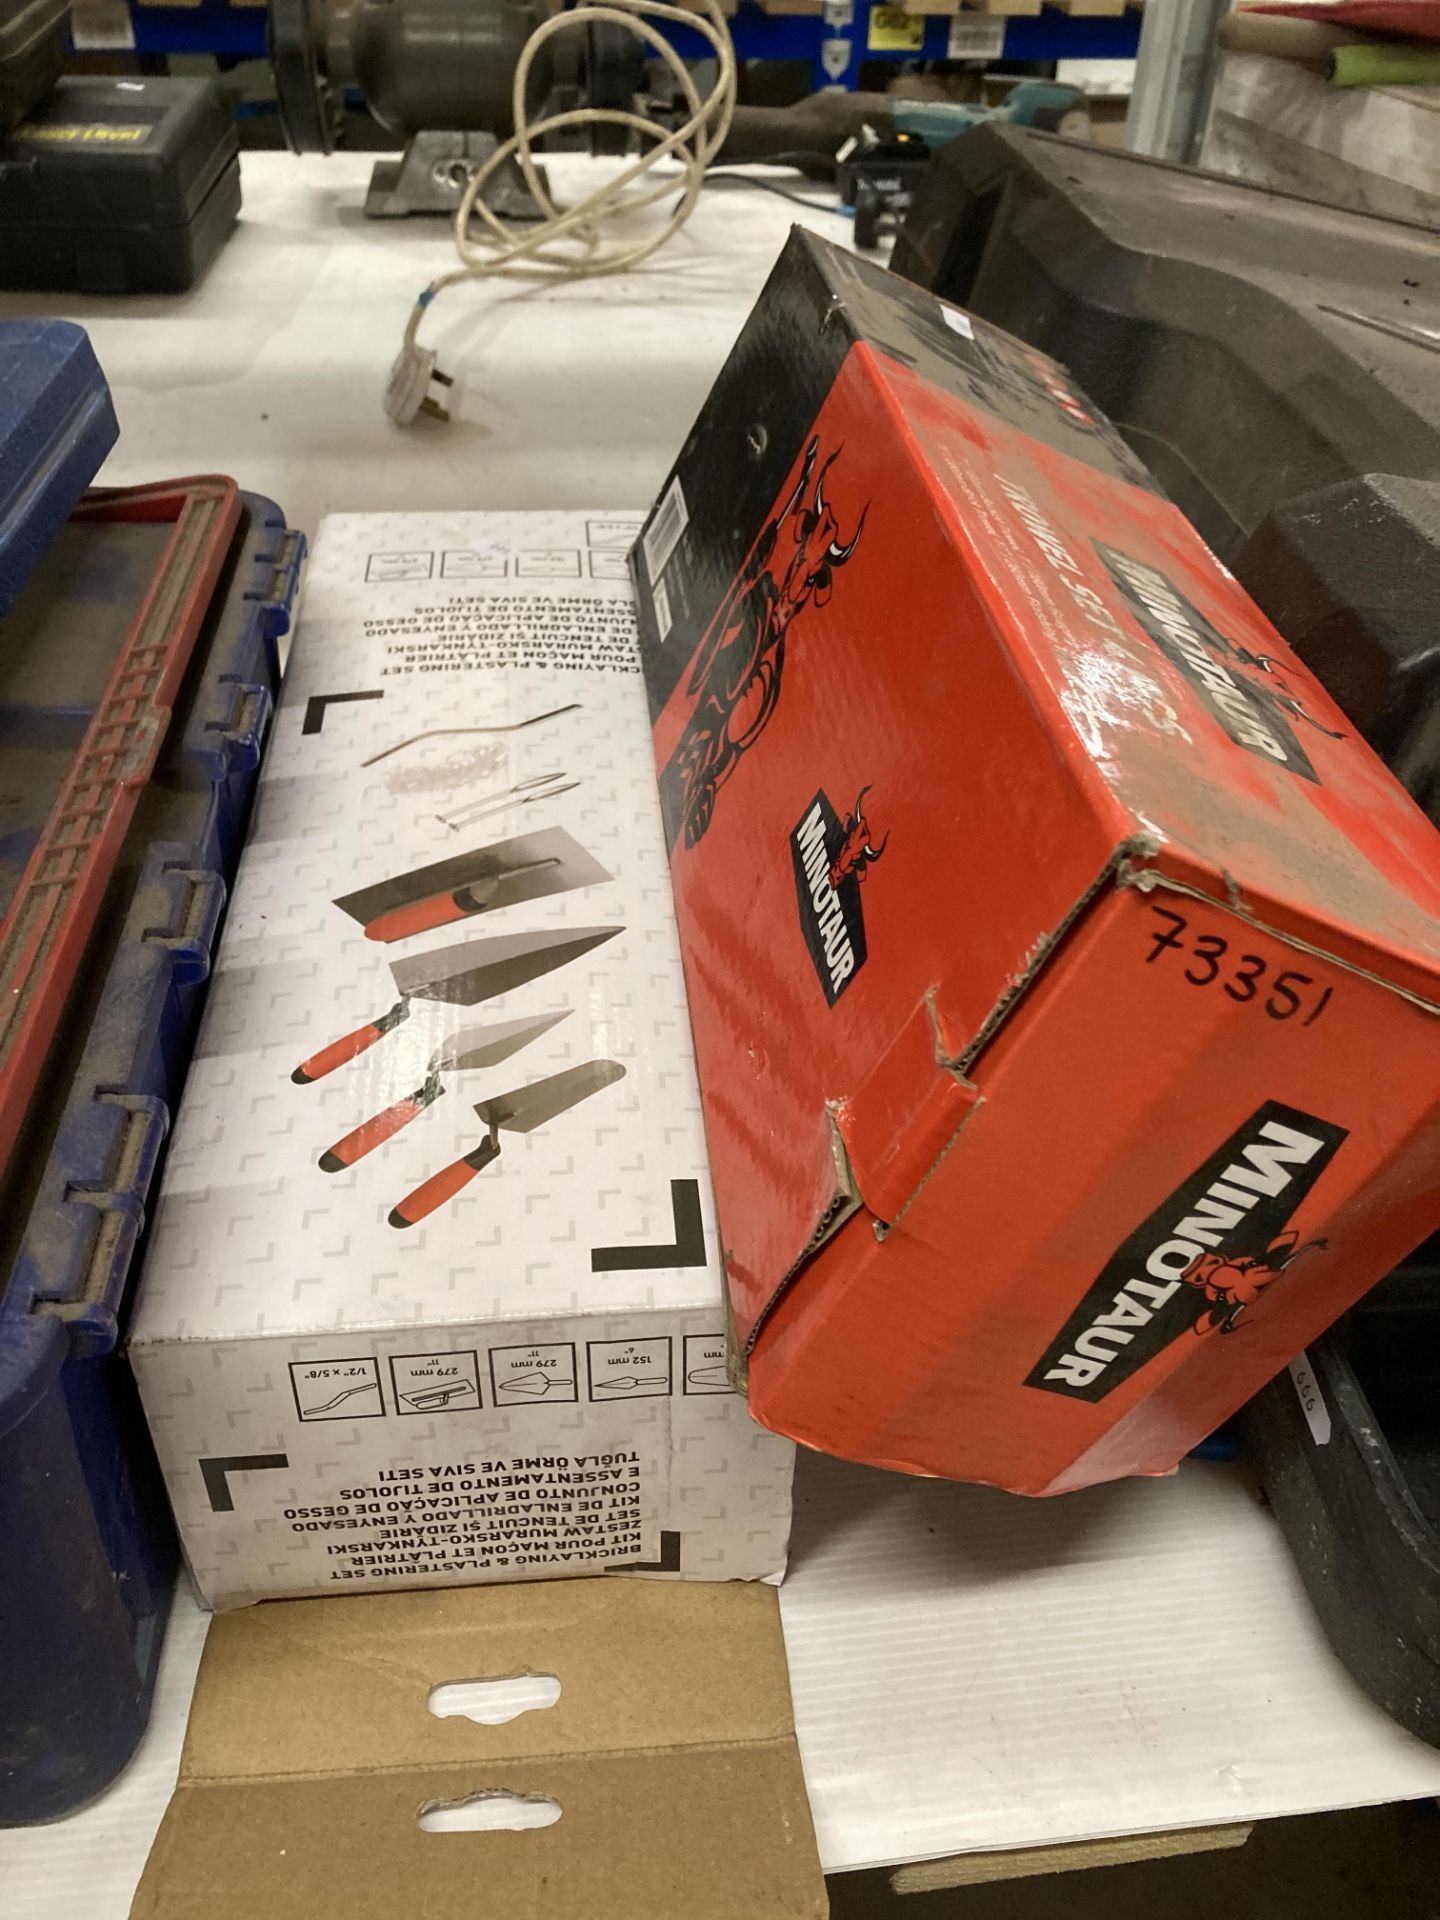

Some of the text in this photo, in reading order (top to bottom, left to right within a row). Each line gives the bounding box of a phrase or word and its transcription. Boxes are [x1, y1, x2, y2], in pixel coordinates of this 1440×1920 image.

[993, 472, 1085, 577] TROWEL
[1059, 573, 1128, 641] SET
[414, 606, 479, 614] TIJOLOS
[363, 617, 418, 628] GESSO
[423, 615, 444, 623] DE
[365, 625, 456, 637] ENYESADO
[477, 623, 605, 633] ENLADRILLADO
[612, 626, 631, 634] DE
[531, 633, 601, 642] TENCUIT
[388, 642, 592, 654] MURARSKO-TYNKARSKI
[591, 654, 636, 663] POUR
[1105, 550, 1288, 761] MINOTAUR
[380, 666, 414, 676] SET
[419, 661, 530, 673] PLASTERING
[553, 662, 640, 673] CKLAYING
[797, 802, 855, 994] MINOTAUR
[1145, 905, 1334, 1027] 73351
[1043, 1121, 1326, 1387] MINOTAUR
[536, 1359, 557, 1367] 279
[607, 1356, 651, 1365] 152 mm
[304, 1369, 330, 1379] 5/8"
[343, 1367, 367, 1376] 1/2"
[437, 1367, 458, 1375] 279
[379, 1452, 640, 1481] TUĞLA ÖRME VE SIVA SETI
[340, 1467, 640, 1500] E ASSENTAMENTO DE TIJOLOS
[284, 1482, 640, 1519] CONJUNTO DE APLICAÇÃO DE GESSO
[292, 1496, 640, 1532] KIT DE ENLADRILLADO Y ENYESADO
[575, 1514, 599, 1524] DE
[605, 1509, 640, 1521] SET
[487, 1517, 569, 1530] TENCUIT
[327, 1520, 641, 1554] ZESTAW MURARSKO-TYNKARSKI
[380, 1524, 457, 1539] ZIDĂRIE
[351, 1532, 641, 1565] KIT POUR MAÇON ET PLÂTRIER
[330, 1544, 641, 1580] BRICKLAYING & PLASTERING SET
